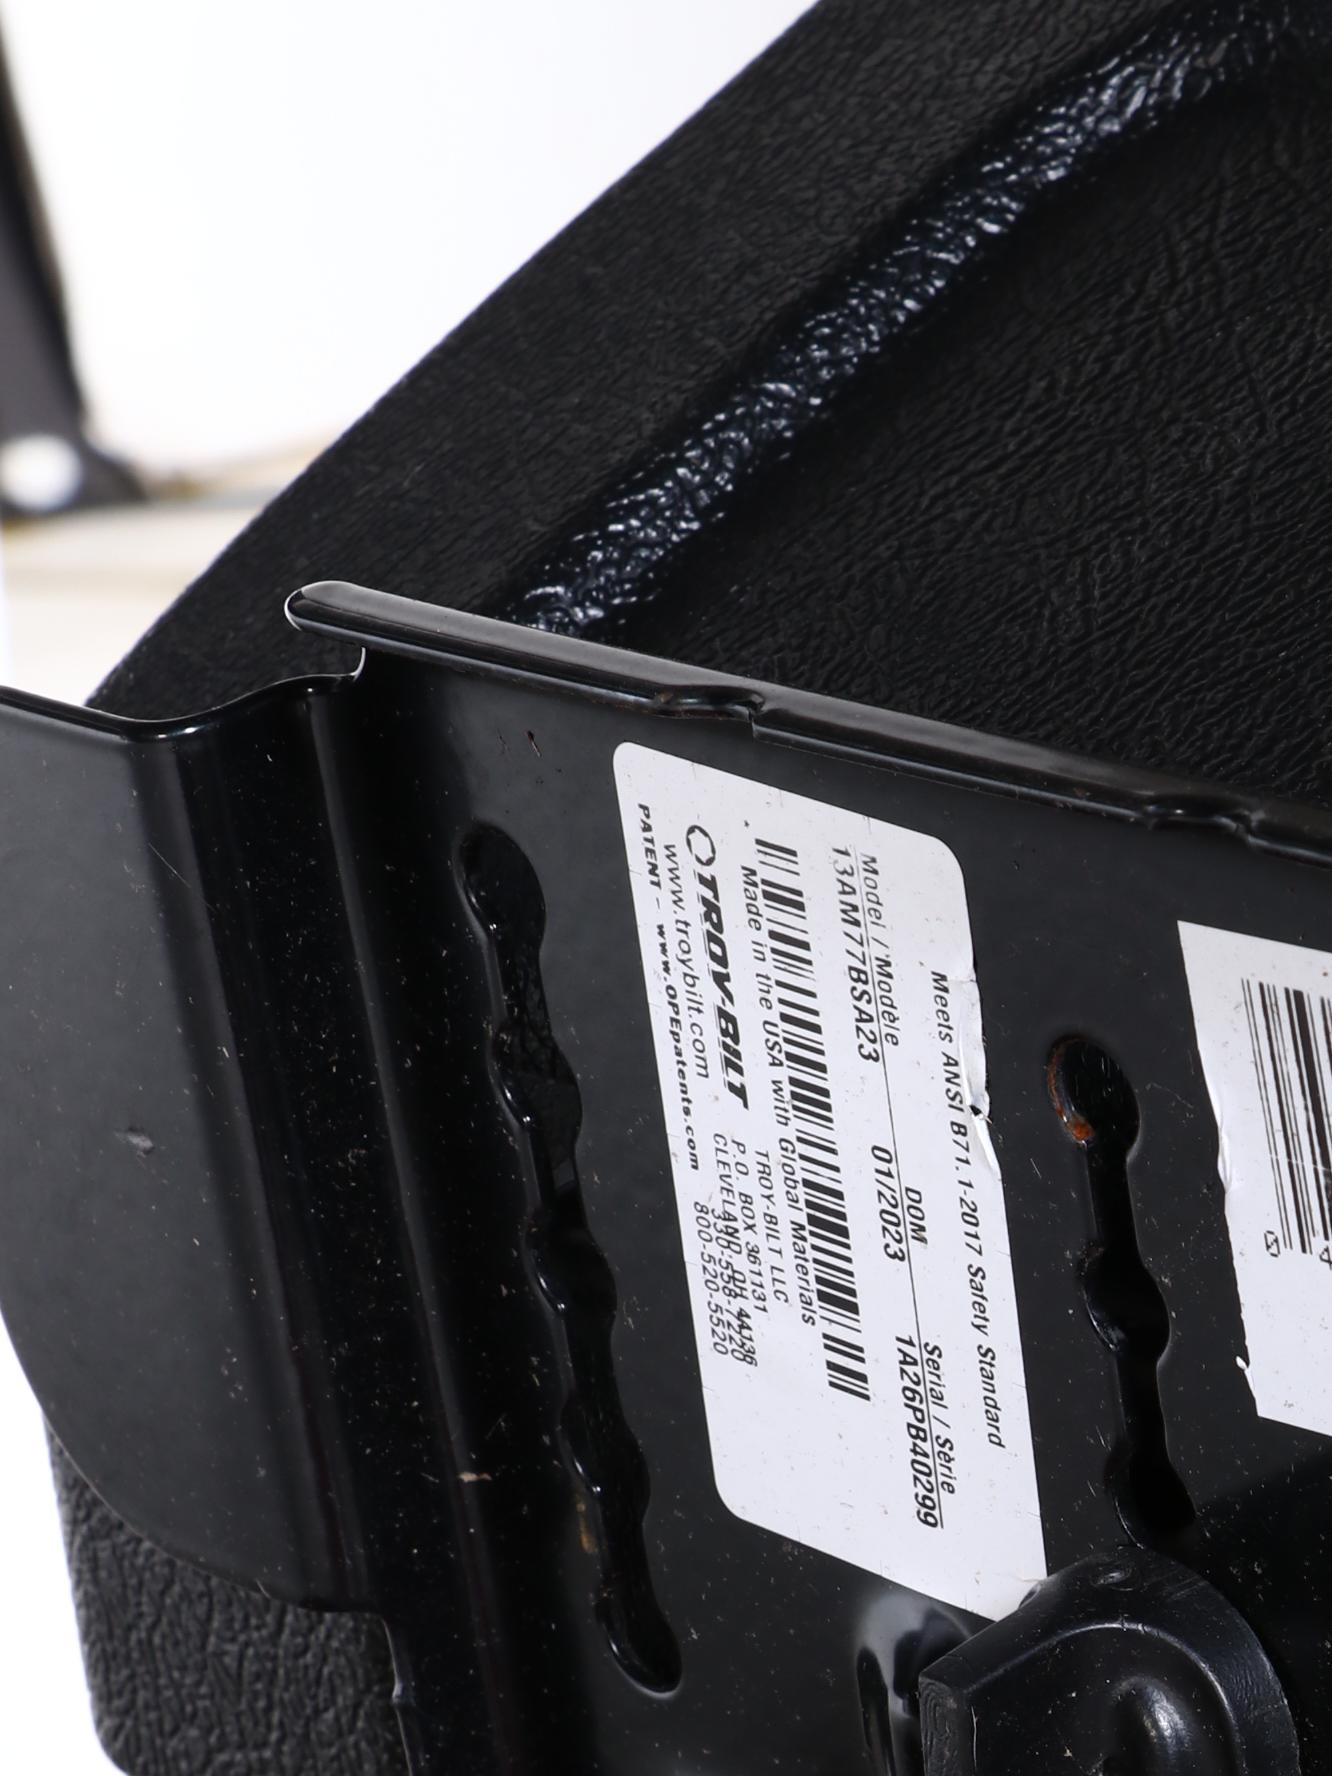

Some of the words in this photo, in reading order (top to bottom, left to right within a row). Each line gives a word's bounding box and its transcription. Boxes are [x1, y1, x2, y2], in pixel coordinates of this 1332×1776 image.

[741, 866, 763, 931] Made
[862, 855, 886, 928] Model
[638, 804, 661, 889] PATENT
[657, 924, 699, 1170] www.OPEpatents.com
[664, 845, 709, 1078] www.troybilt.com
[752, 941, 767, 962] in
[833, 848, 880, 1062] 13AM77BSA23
[694, 870, 748, 1110] TROY-BILT
[756, 973, 773, 1010] the
[931, 971, 953, 1043] Meets
[763, 1020, 784, 1067] USA
[771, 1080, 791, 1126] with
[942, 1052, 964, 1112] ANSI
[731, 1139, 749, 1180] P.O.
[779, 1138, 803, 1212] Global
[950, 1121, 982, 1256] B71.1-2017
[738, 1192, 757, 1235] BOX
[755, 1151, 783, 1258] TROY-BILT
[770, 1265, 789, 1303] LLC
[871, 1145, 905, 1262] 01/2023
[905, 1187, 927, 1244] DOM
[694, 1202, 729, 1355] 800-520-5520
[746, 1242, 768, 1313] 361131
[790, 1220, 817, 1326] Materials
[968, 1264, 989, 1336] Safety
[924, 1342, 948, 1409] Serial
[977, 1344, 1005, 1448] Standard
[896, 1336, 938, 1528] 1A26PB40299
